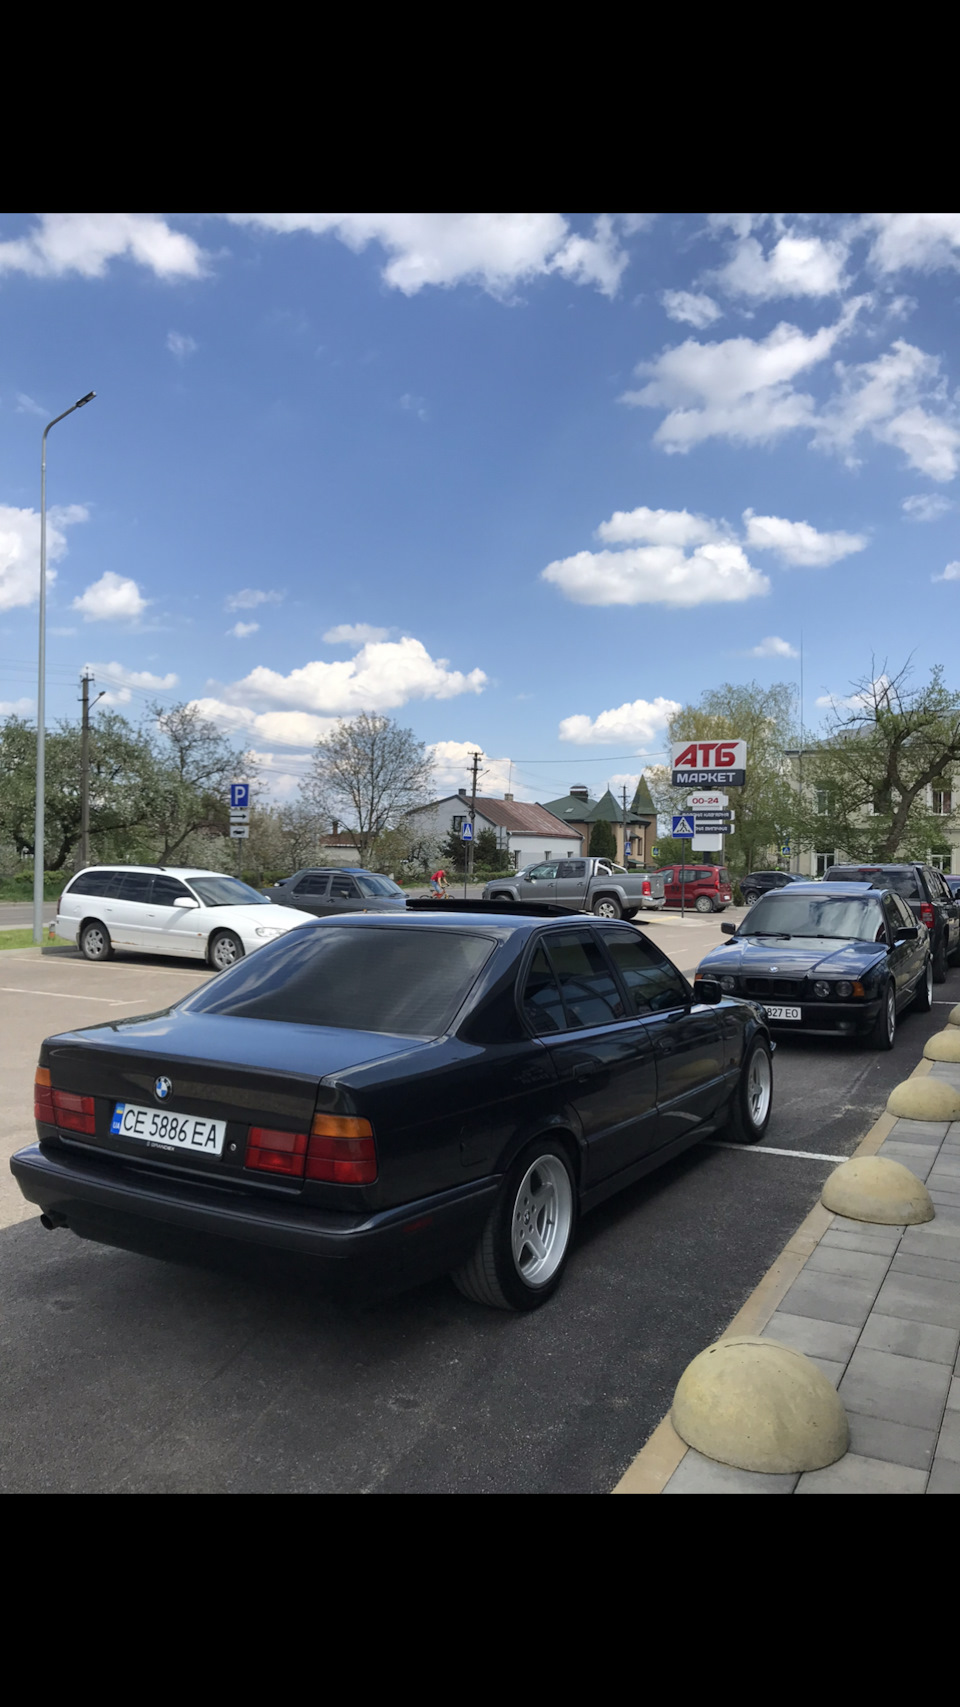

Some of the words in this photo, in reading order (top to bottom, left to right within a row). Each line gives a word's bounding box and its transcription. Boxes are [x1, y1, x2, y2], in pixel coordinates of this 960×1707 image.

[675, 743, 739, 767] АТБ
[677, 773, 735, 783] МАРКЕТ
[234, 785, 246, 805] P
[785, 1009, 798, 1018] EO
[124, 1109, 147, 1134] CE
[149, 1114, 189, 1142] 5886
[191, 1121, 216, 1148] EA
